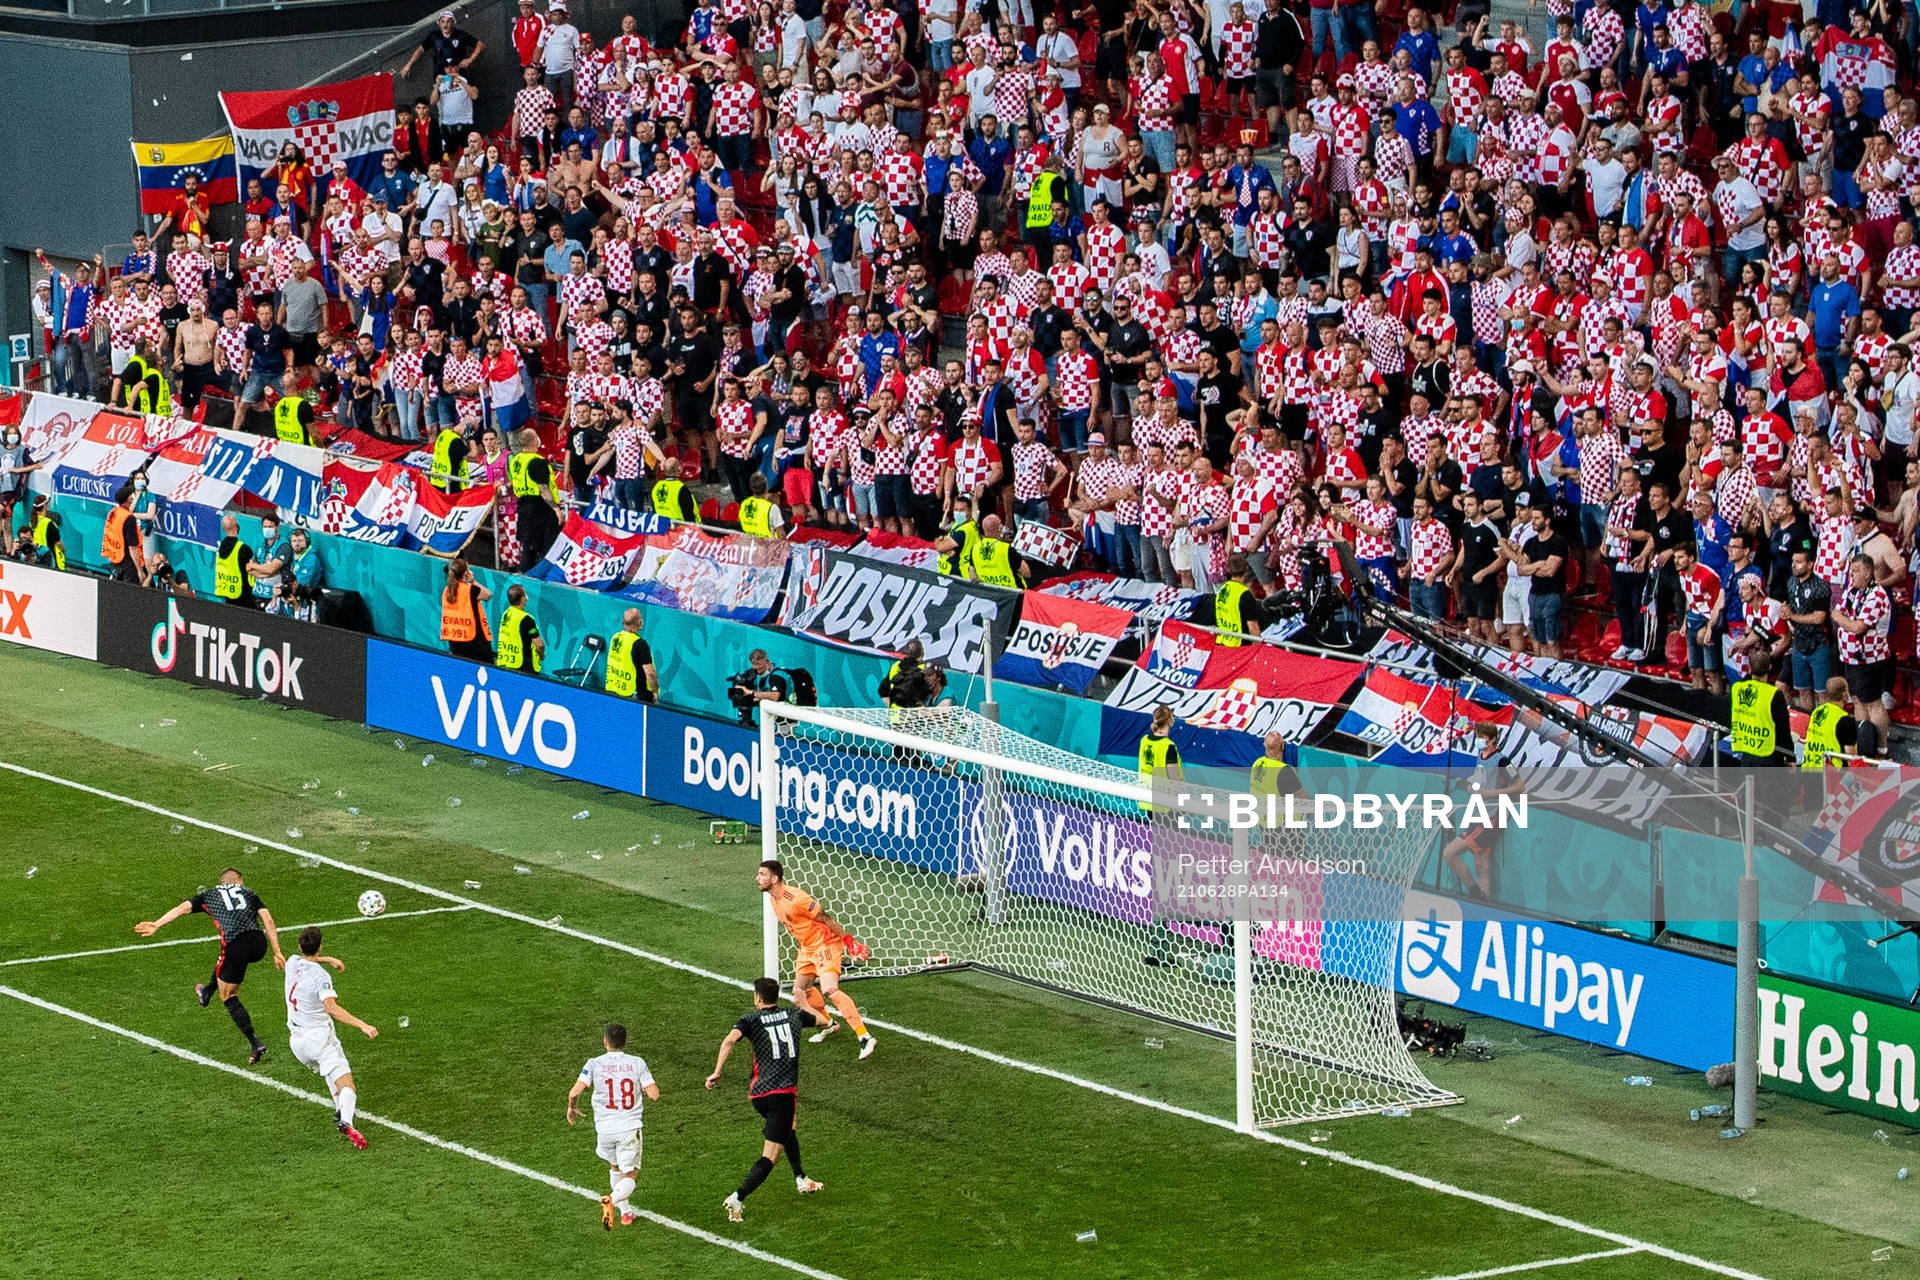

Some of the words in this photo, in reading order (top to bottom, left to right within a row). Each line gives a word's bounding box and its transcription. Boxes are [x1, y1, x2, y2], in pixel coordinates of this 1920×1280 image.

[339, 121, 392, 154] NAC
[106, 421, 143, 445] KÖL
[199, 437, 321, 518] ŠIBENIK
[154, 504, 198, 537] KÖLN
[801, 560, 998, 674] POSUŠJE
[190, 622, 304, 700] TikTok
[1012, 626, 1107, 662] POSUŠJE
[431, 666, 577, 768] vivo
[1034, 808, 1303, 940] Volkswaen
[218, 886, 247, 911] 15
[288, 981, 298, 1012] 4
[1471, 919, 1645, 1047] Alipay
[764, 1022, 796, 1059] 14
[605, 1078, 635, 1110] 18
